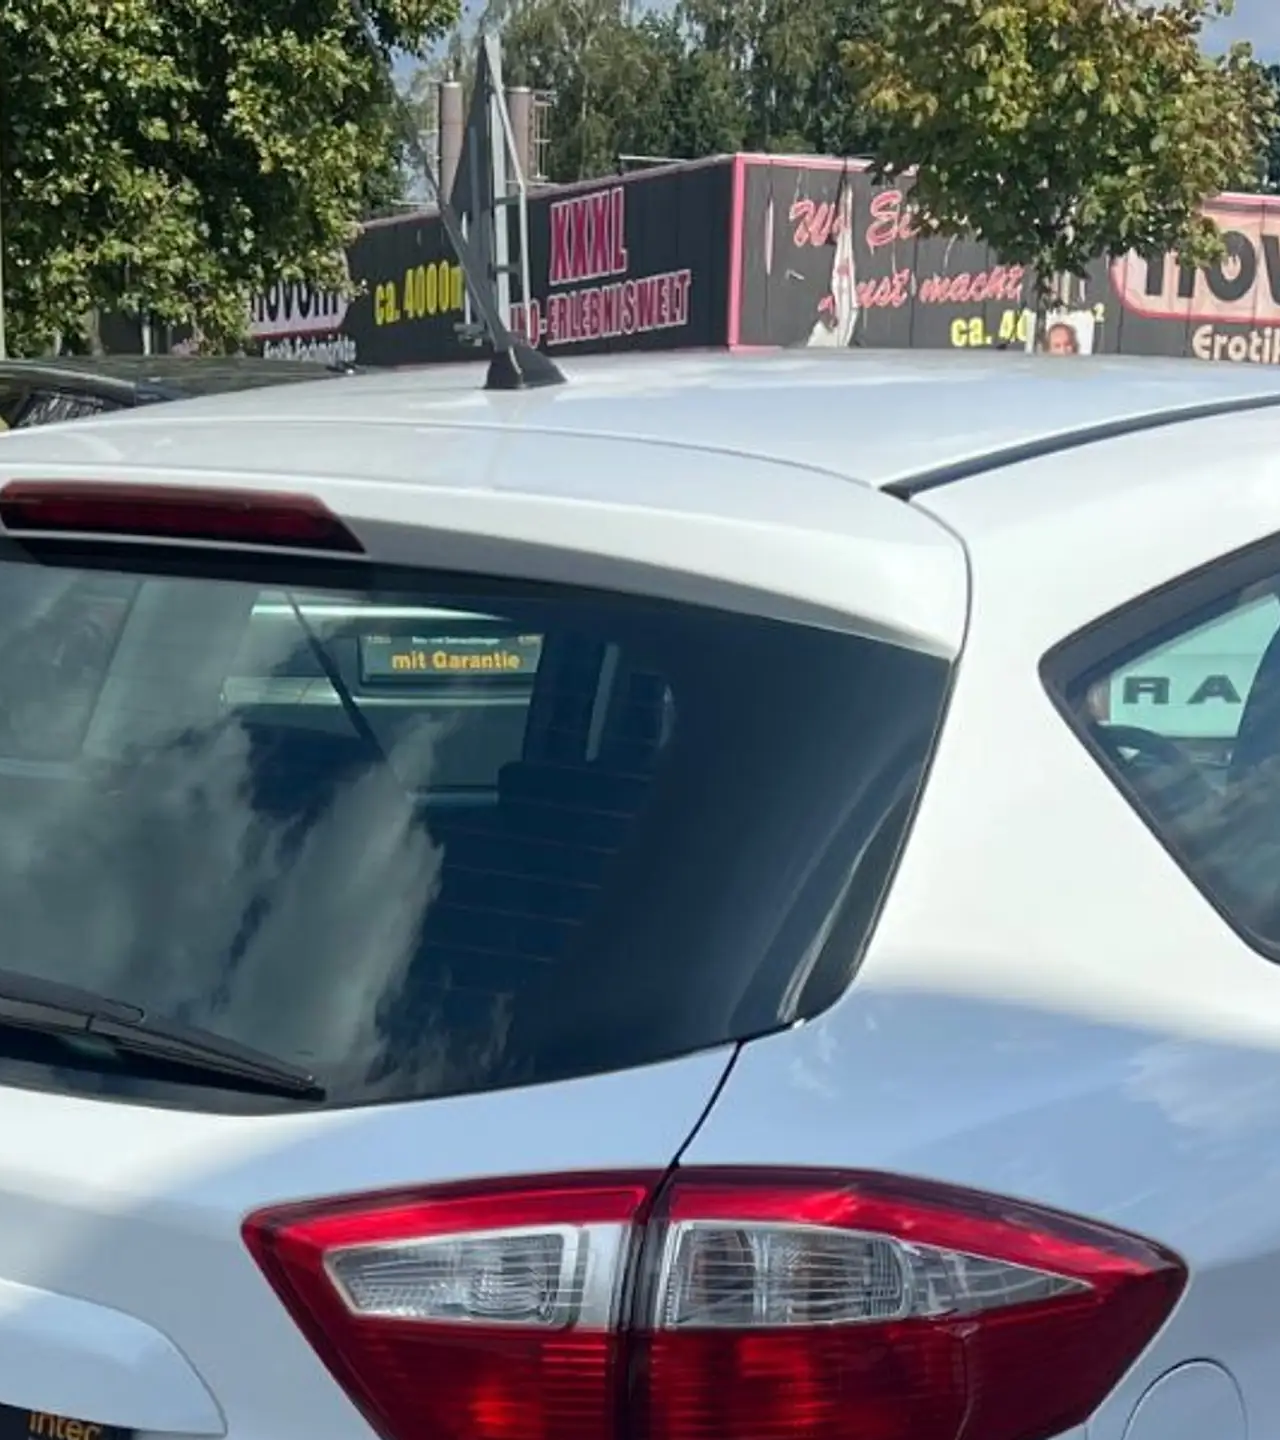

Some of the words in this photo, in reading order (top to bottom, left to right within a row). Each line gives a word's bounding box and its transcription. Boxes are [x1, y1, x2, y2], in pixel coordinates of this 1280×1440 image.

[549, 186, 628, 286] XXXL
[375, 280, 400, 326] ca.
[951, 316, 993, 348] ca.
[392, 650, 426, 670] mit
[432, 650, 520, 670] Garantie
